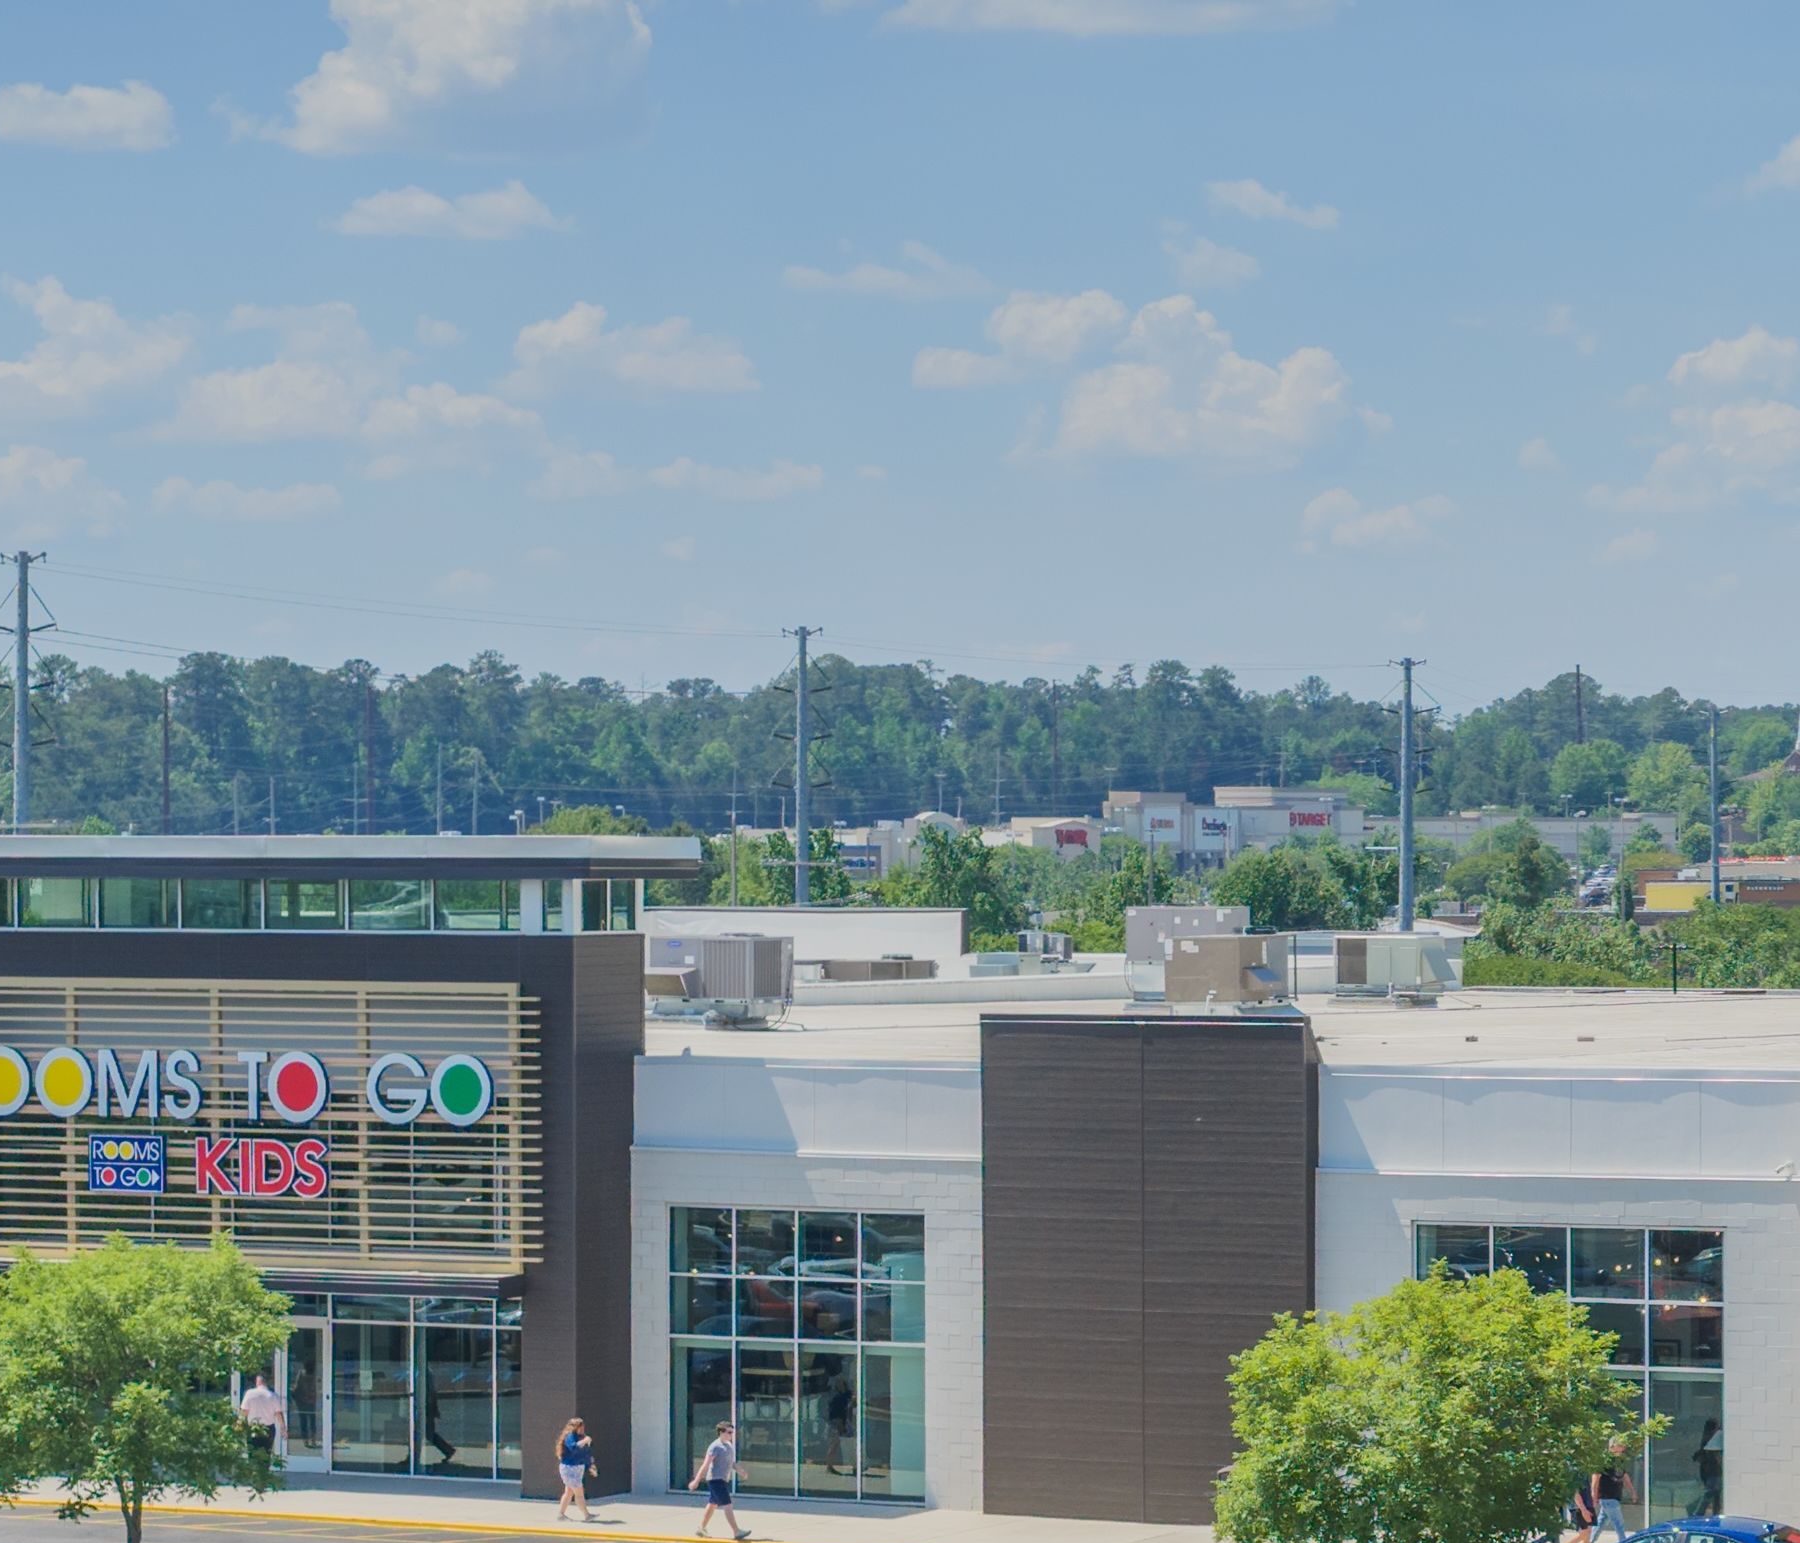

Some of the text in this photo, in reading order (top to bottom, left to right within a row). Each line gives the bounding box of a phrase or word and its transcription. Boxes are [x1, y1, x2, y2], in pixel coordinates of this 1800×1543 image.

[236, 1050, 330, 1125] TO
[366, 1052, 494, 1127] GO
[93, 1140, 160, 1162] ROOMS
[195, 1136, 327, 1199] KIDS
[93, 1166, 152, 1187] TO GO
